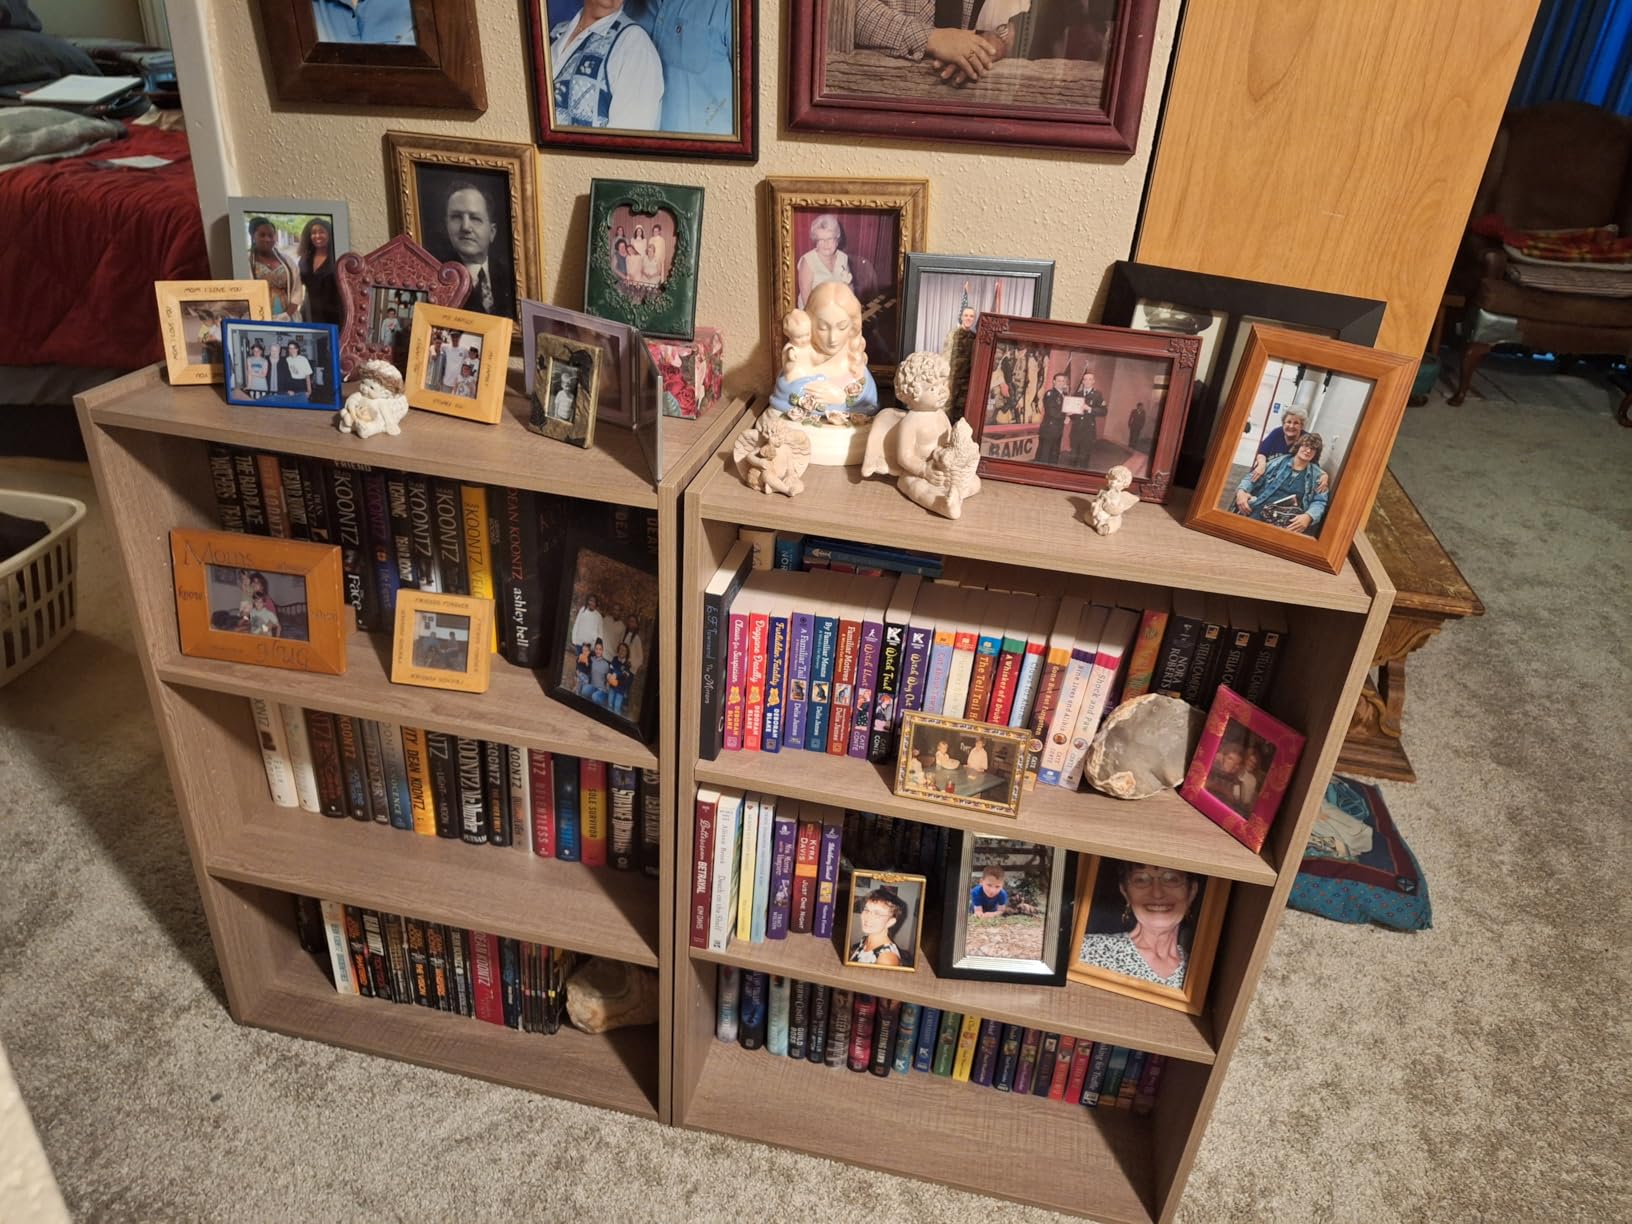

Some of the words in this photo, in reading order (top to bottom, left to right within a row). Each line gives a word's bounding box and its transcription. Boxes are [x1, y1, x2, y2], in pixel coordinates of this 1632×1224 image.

[334, 474, 360, 546] KOONTZ
[388, 480, 407, 518] LIGHTNING
[408, 487, 432, 556] KOONTZ
[436, 492, 460, 563] KOONTZ
[464, 508, 483, 565] KOONTZ
[510, 526, 523, 581] KOONTZ
[348, 574, 362, 610] Face
[513, 587, 526, 624] ashley
[516, 626, 528, 647] bell
[734, 620, 744, 642] Claws
[824, 622, 832, 631] By
[799, 635, 808, 665] Familiar
[822, 632, 831, 657] Familiar
[846, 626, 856, 654] Familiar
[864, 644, 874, 666] Witch
[886, 647, 898, 670] Witch
[978, 656, 990, 672] The
[1194, 642, 1210, 665] STELLA
[1224, 650, 1240, 672] STELLA
[1254, 650, 1269, 674] STELLA
[731, 650, 742, 683] Suspicion
[750, 655, 762, 682] Deadly
[770, 658, 783, 686] Fatality
[798, 665, 806, 679] Tail
[820, 657, 829, 678] Means
[842, 654, 852, 681] Motives
[910, 654, 922, 676] Witch
[998, 661, 1012, 688] Whisker
[1048, 666, 1059, 682] Gone
[1160, 648, 1180, 689] ROBERTS
[1172, 656, 1189, 684] NORA
[704, 674, 714, 704] Mirrors
[862, 669, 872, 687] Hunt
[882, 672, 894, 691] Trial
[904, 676, 919, 692] Way
[974, 676, 985, 692] Tell
[1046, 683, 1055, 694] But
[1092, 674, 1106, 698] Shock
[1186, 666, 1204, 701] CAMERON
[904, 694, 914, 706] Out
[998, 690, 1006, 698] of
[1042, 694, 1052, 705] Not
[1068, 682, 1080, 698] Lives
[970, 694, 982, 710] Tail
[1064, 700, 1075, 712] and
[1086, 700, 1096, 715] and
[726, 710, 734, 730] BLAKE
[746, 710, 754, 729] BLAKE
[765, 712, 773, 732] BLAKE
[772, 708, 780, 738] DEBORAH
[992, 704, 1004, 724] Doubt
[1059, 713, 1072, 732] Alibis
[1082, 717, 1091, 732] Paw
[792, 718, 800, 736] James
[852, 731, 860, 752] CONTE
[872, 734, 880, 756] CONTE
[408, 750, 420, 772] DEAN
[488, 742, 500, 785] KOONTZ
[510, 746, 522, 789] KOONTZ
[1029, 756, 1038, 769] CATE
[412, 777, 425, 810] KOONTZ
[588, 788, 597, 804] SOLE
[464, 804, 482, 834] Murder
[535, 782, 548, 843] RELENTLESS
[588, 806, 598, 838] SURVIVOR
[799, 838, 808, 861] DAVIS
[808, 840, 816, 860] KYRA
[696, 861, 707, 894] BETRAYAL
[696, 916, 704, 930] DAVIS
[798, 911, 806, 930] NIGHT
[476, 955, 490, 986] KOONTZ
[859, 1005, 870, 1017] THE
[836, 1014, 848, 1032] SLEEP
[856, 1018, 866, 1036] NIGHT
[796, 1027, 804, 1046] GUILD
[836, 1032, 846, 1041] NO
[878, 1020, 890, 1049] SHATTERING
[854, 1036, 865, 1058] ISLAND
[877, 1049, 886, 1064] DAWN
